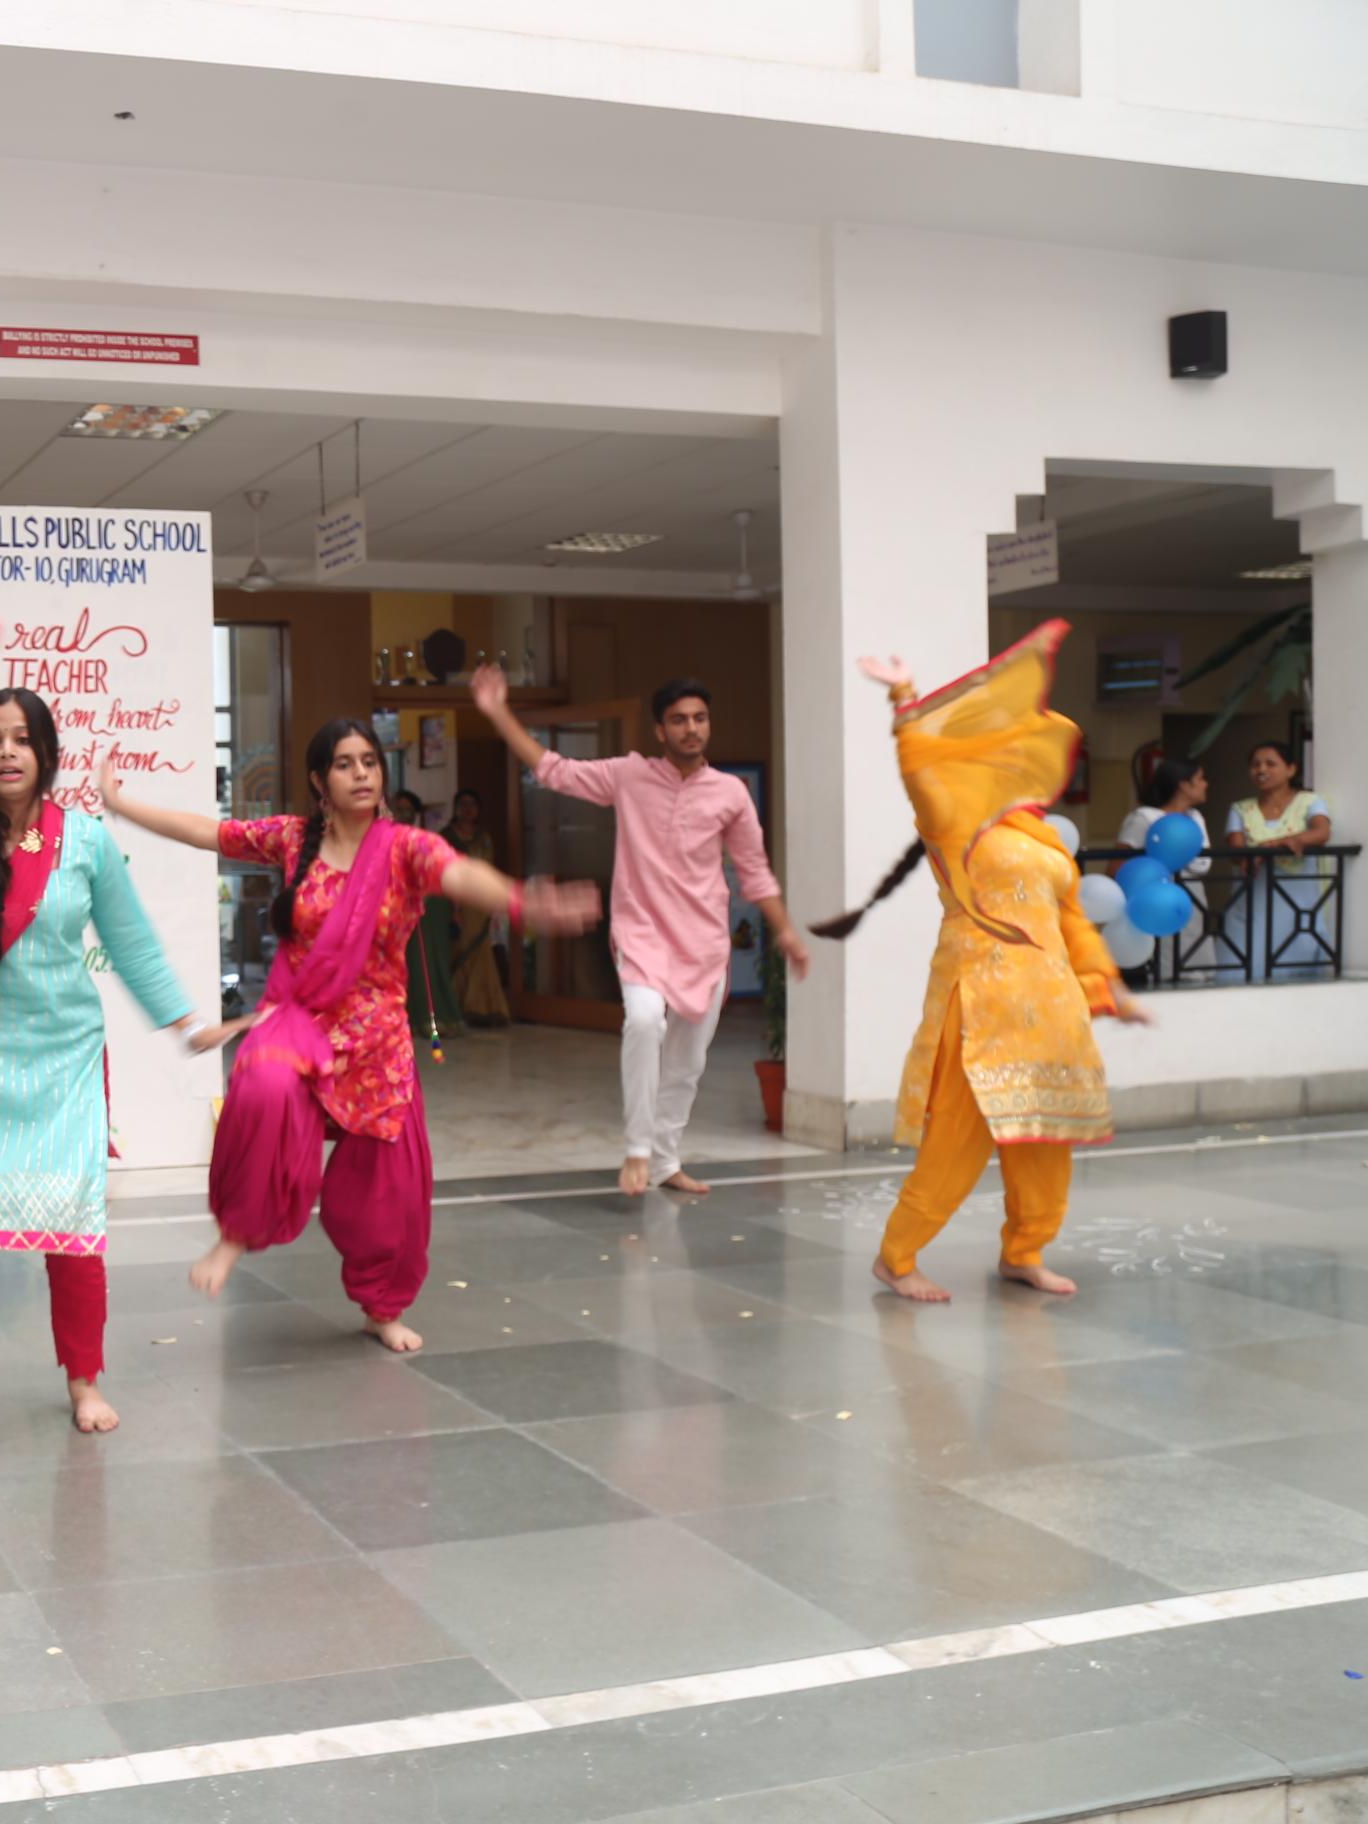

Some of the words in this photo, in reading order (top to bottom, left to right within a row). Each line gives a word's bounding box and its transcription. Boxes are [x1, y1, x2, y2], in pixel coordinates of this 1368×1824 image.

[44, 517, 116, 551] PUBLIC
[124, 519, 207, 552] SCHOOL
[5, 607, 148, 657] real
[3, 658, 108, 694] TEACHER
[107, 698, 180, 731] heart
